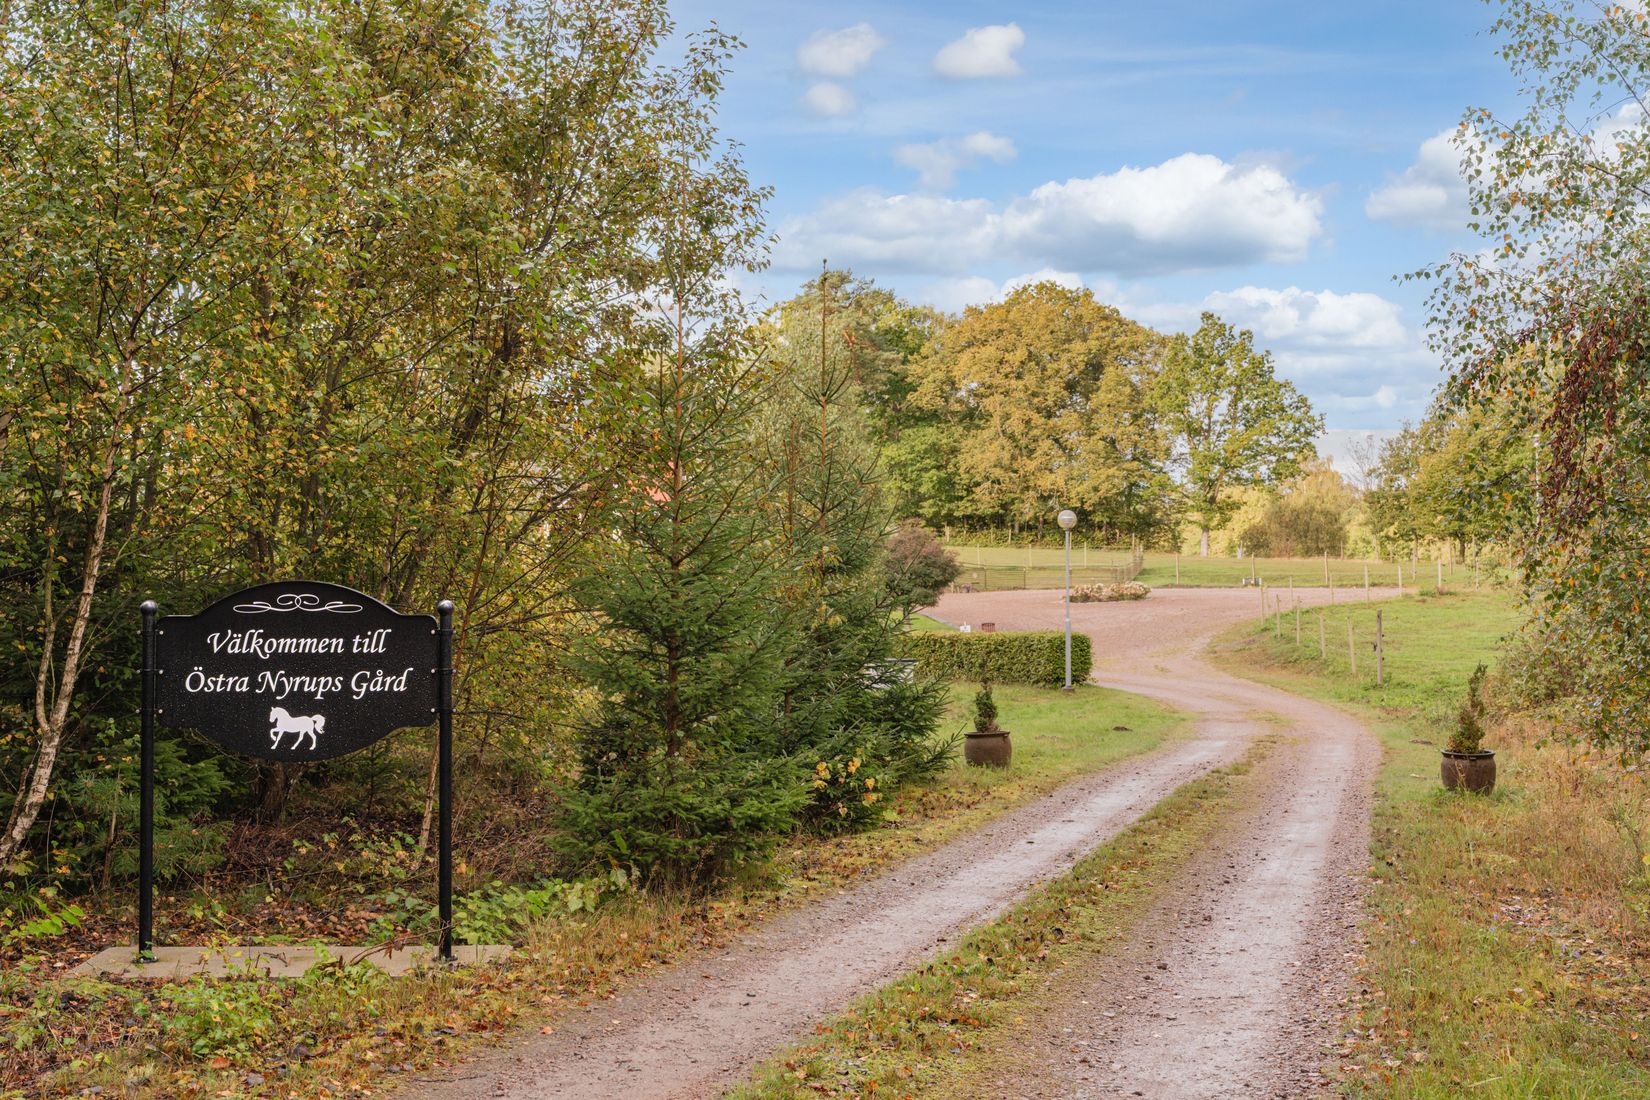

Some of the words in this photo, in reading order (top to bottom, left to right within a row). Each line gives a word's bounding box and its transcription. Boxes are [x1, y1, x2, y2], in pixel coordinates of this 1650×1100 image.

[207, 629, 345, 659] Välkommen
[352, 629, 392, 654] till
[185, 666, 250, 693] Östra
[255, 670, 343, 700] Nyrups
[350, 667, 414, 700] Gård
